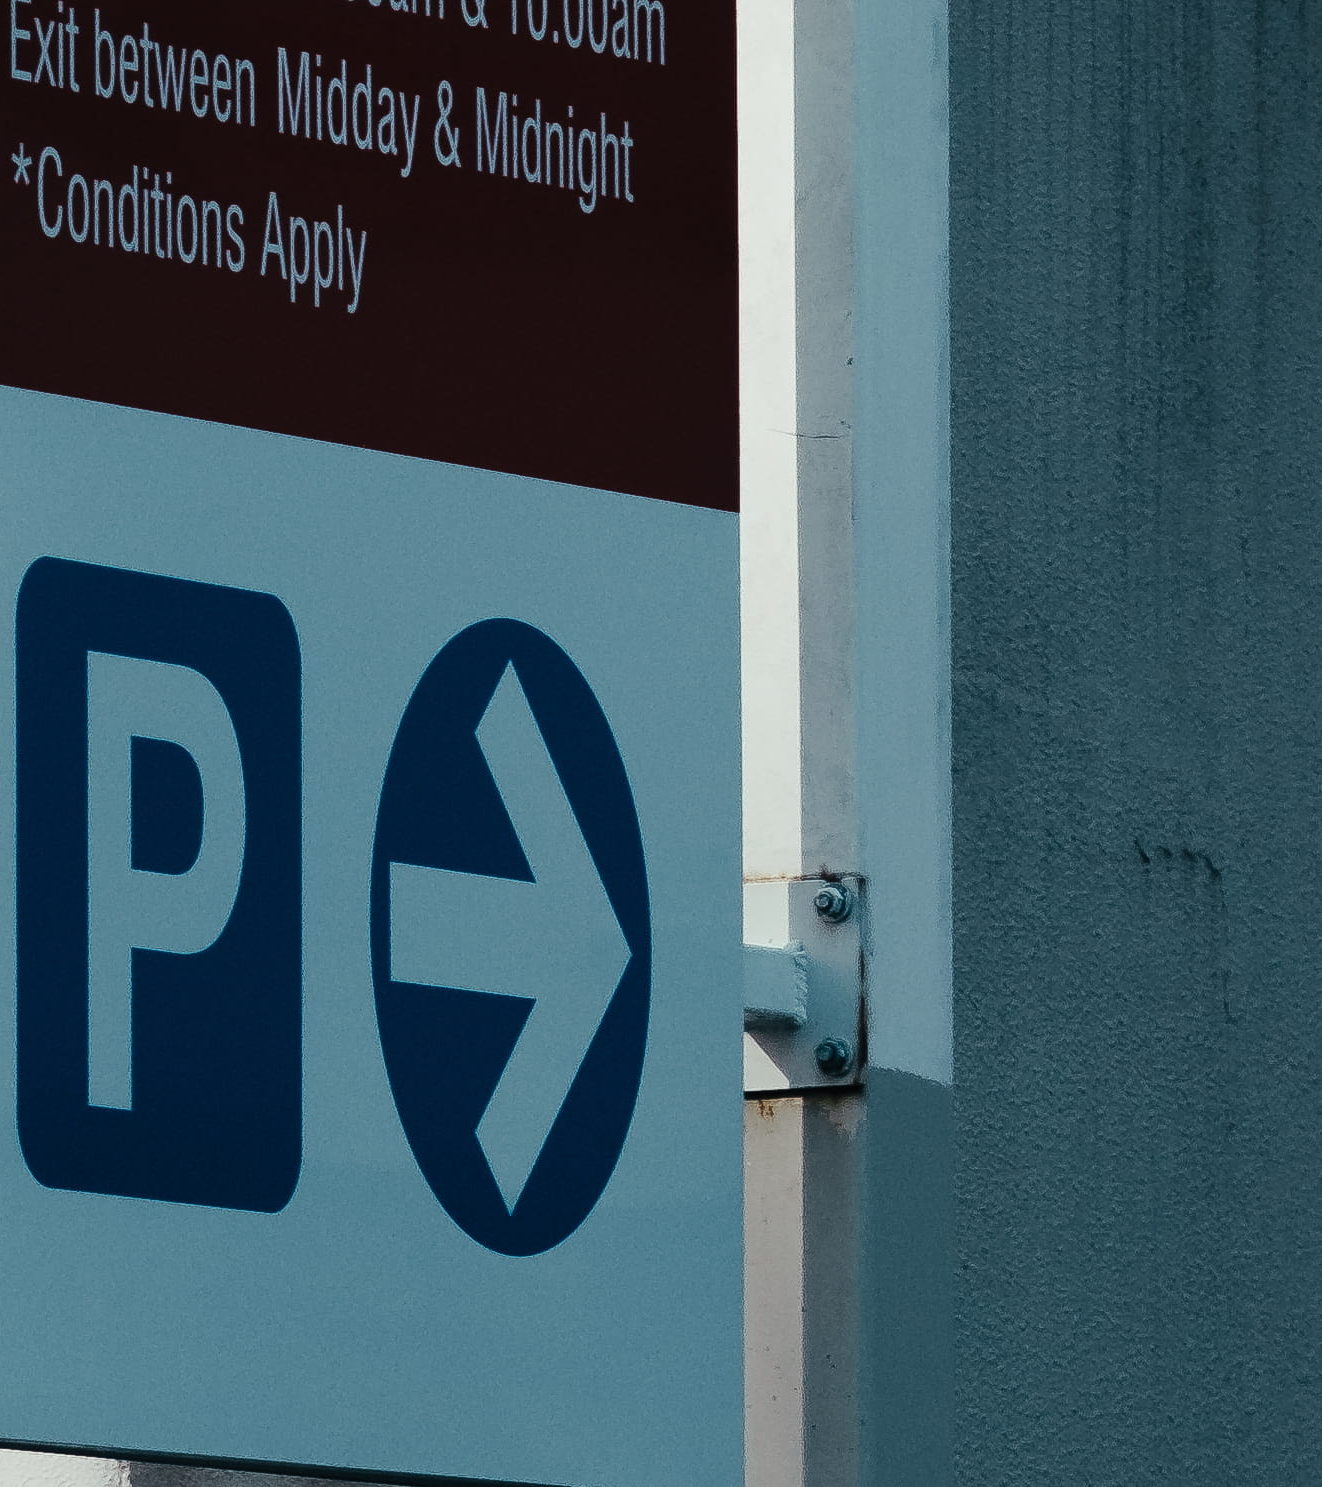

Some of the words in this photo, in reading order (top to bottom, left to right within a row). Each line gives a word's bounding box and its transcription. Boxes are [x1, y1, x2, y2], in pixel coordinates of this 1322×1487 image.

[10, 0, 80, 93] Exit
[94, 8, 256, 127] between
[277, 46, 421, 178] Midday
[434, 80, 462, 168] &
[476, 86, 634, 214] Midnight
[260, 191, 367, 314] Apply
[87, 649, 247, 1112] P
